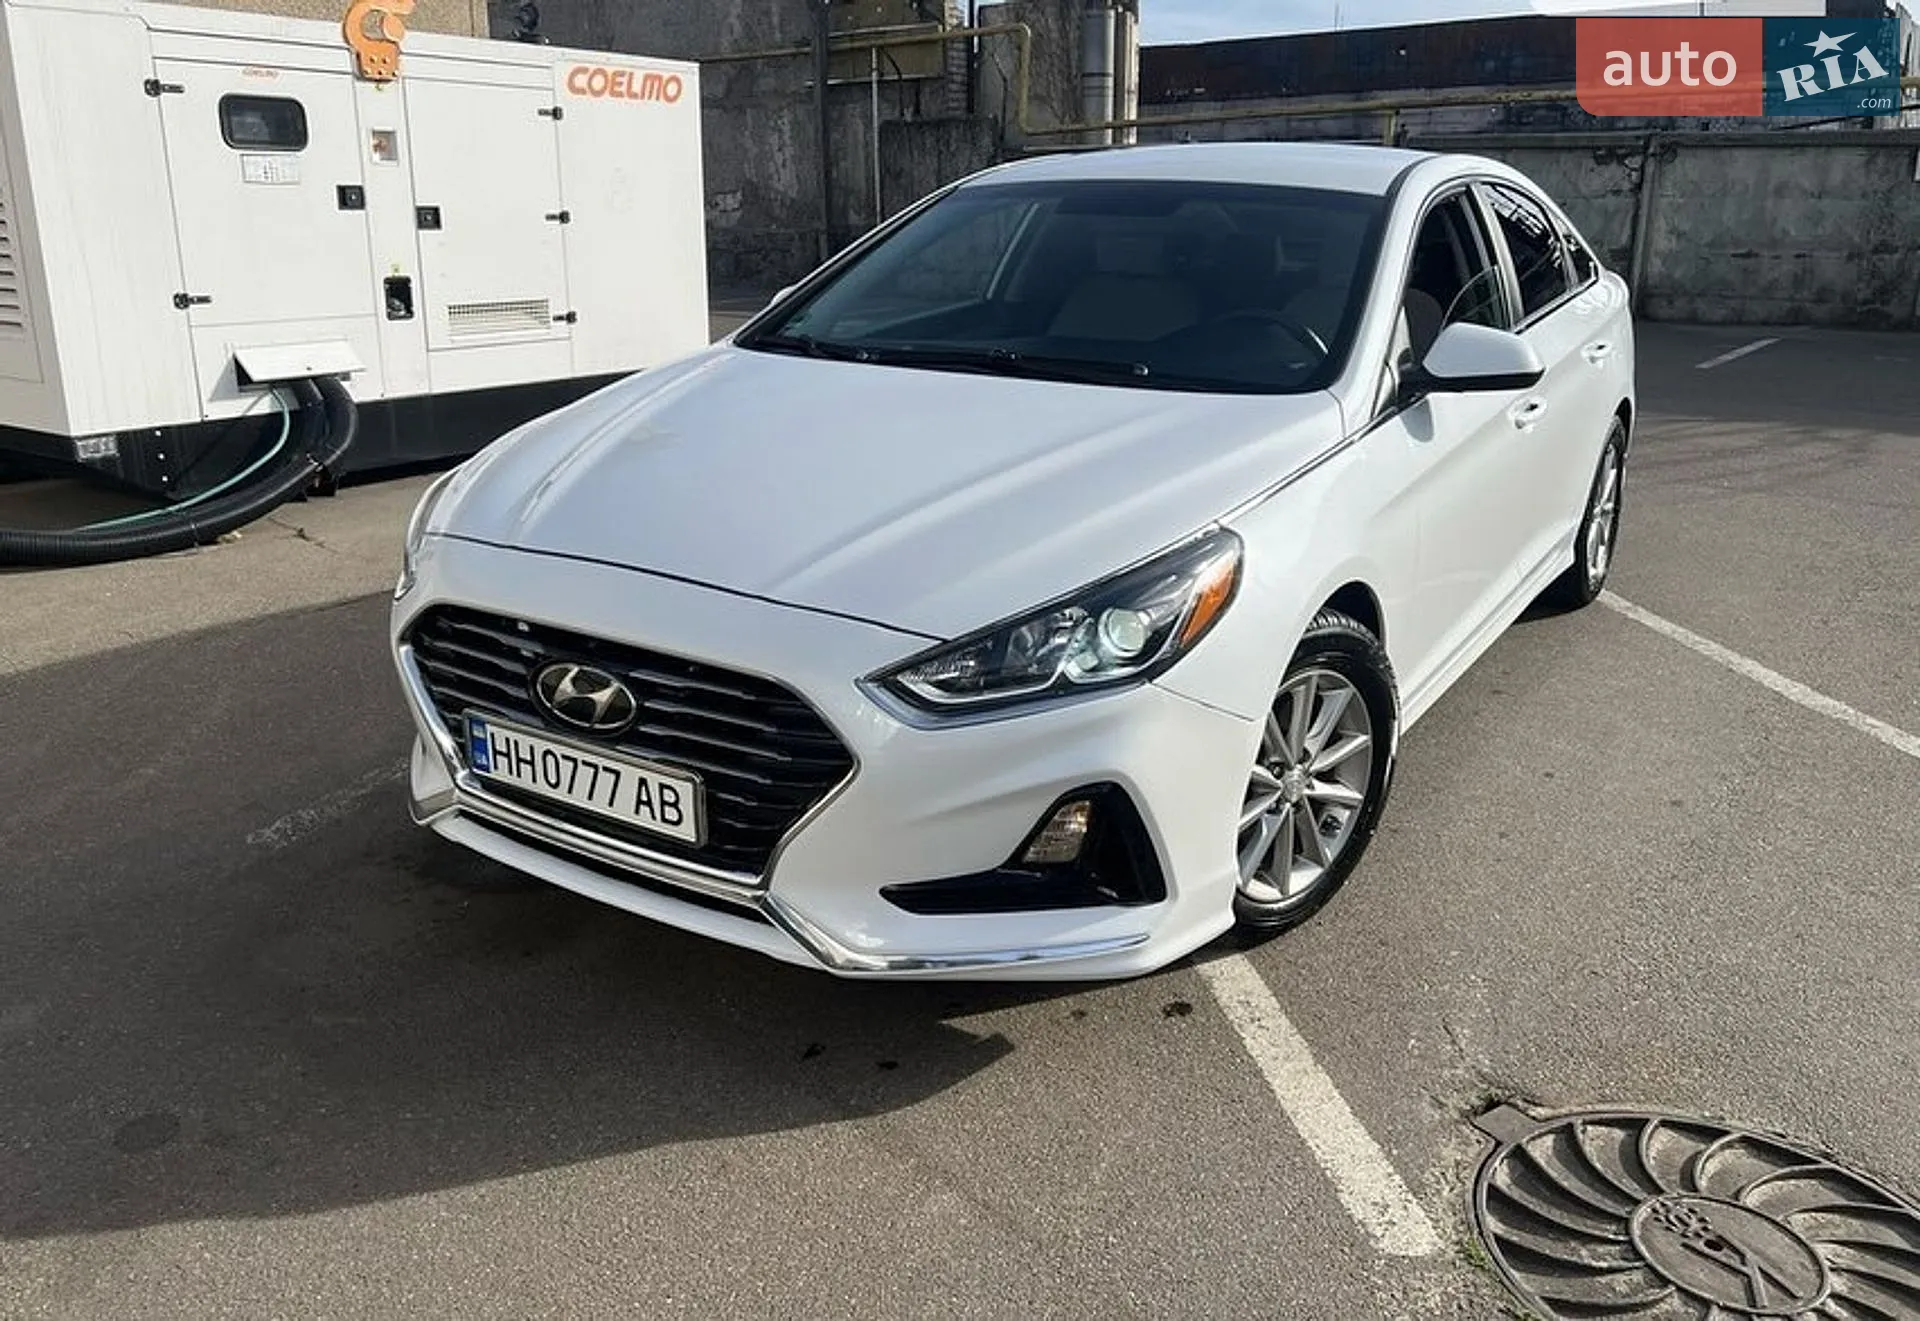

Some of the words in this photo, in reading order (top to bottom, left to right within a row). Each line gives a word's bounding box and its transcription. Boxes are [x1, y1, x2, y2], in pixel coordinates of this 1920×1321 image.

[567, 66, 683, 104] COELMO
[490, 731, 621, 808] HH0777
[634, 776, 683, 827] AB
